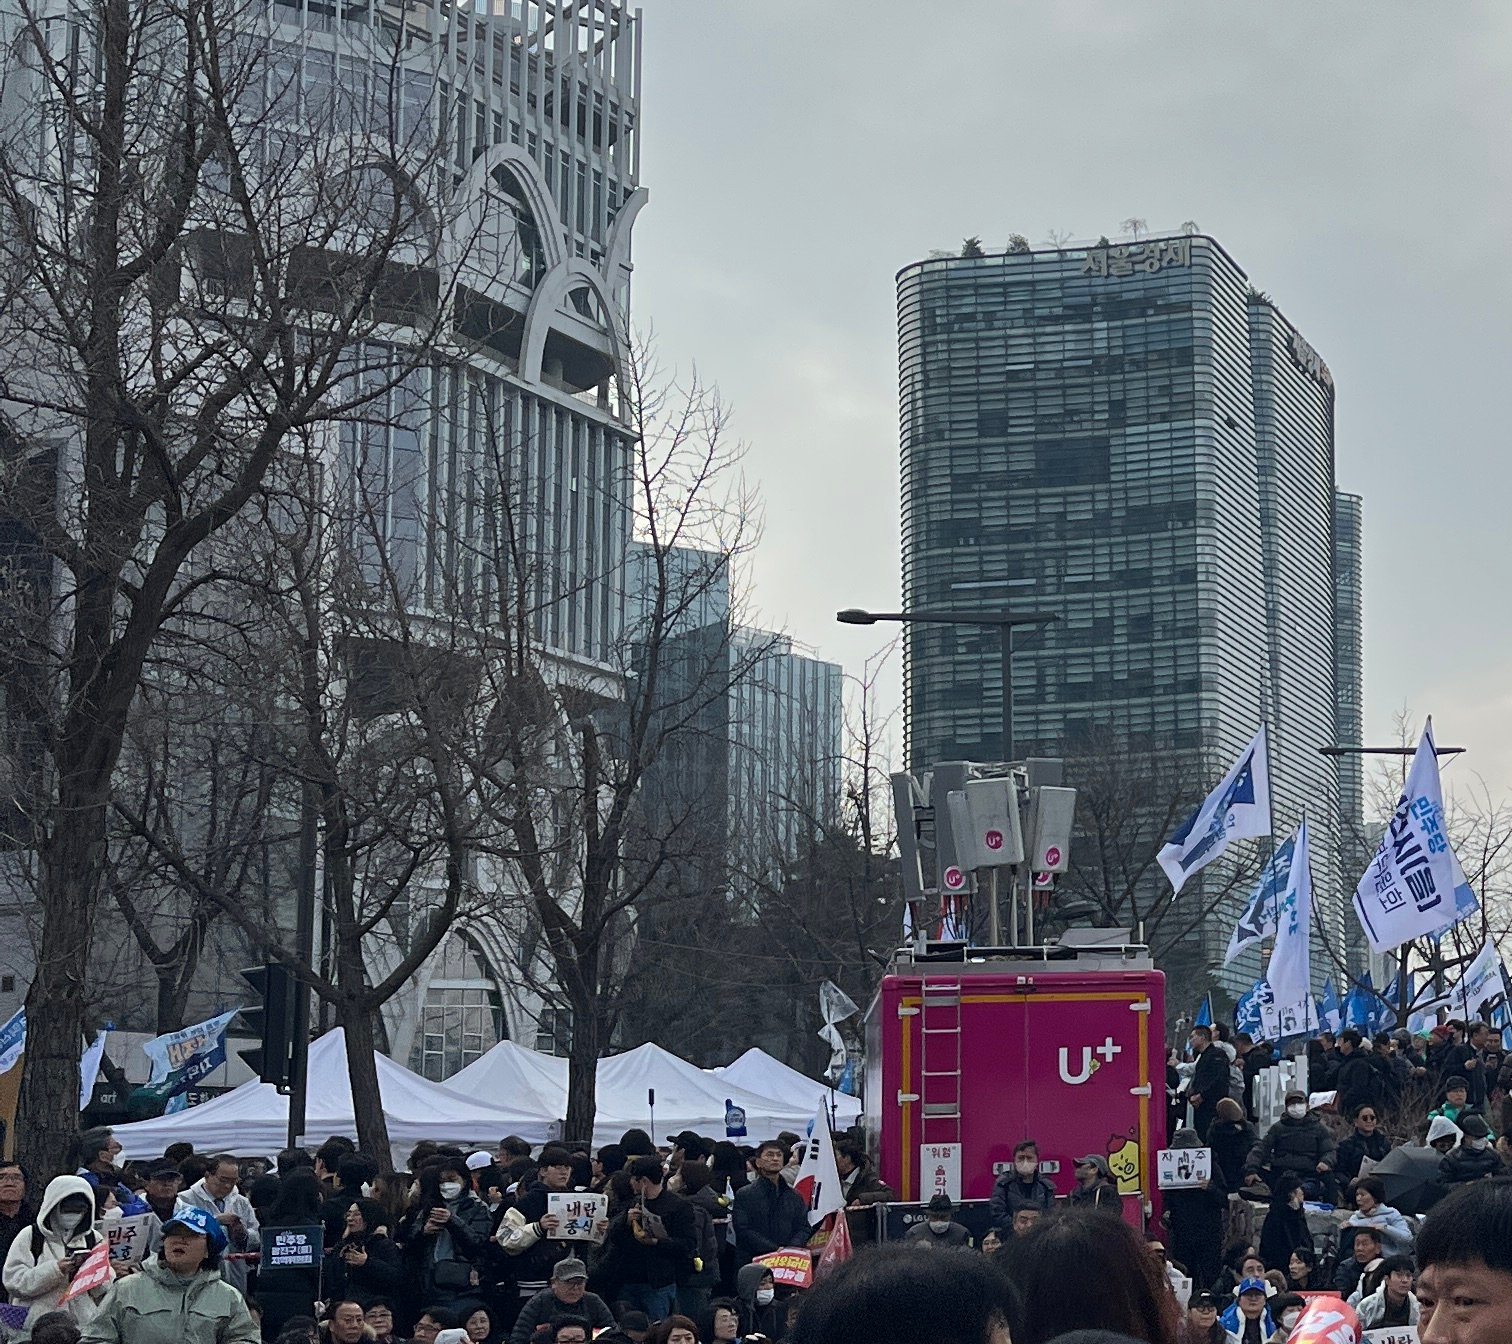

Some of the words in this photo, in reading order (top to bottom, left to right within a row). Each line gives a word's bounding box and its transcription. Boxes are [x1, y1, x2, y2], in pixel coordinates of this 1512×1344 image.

[1081, 239, 1191, 278] 서울경제
[1410, 796, 1447, 854] 민주당
[1059, 1037, 1121, 1084] U+
[566, 1201, 597, 1217] 내란
[108, 1226, 136, 1245] 민주
